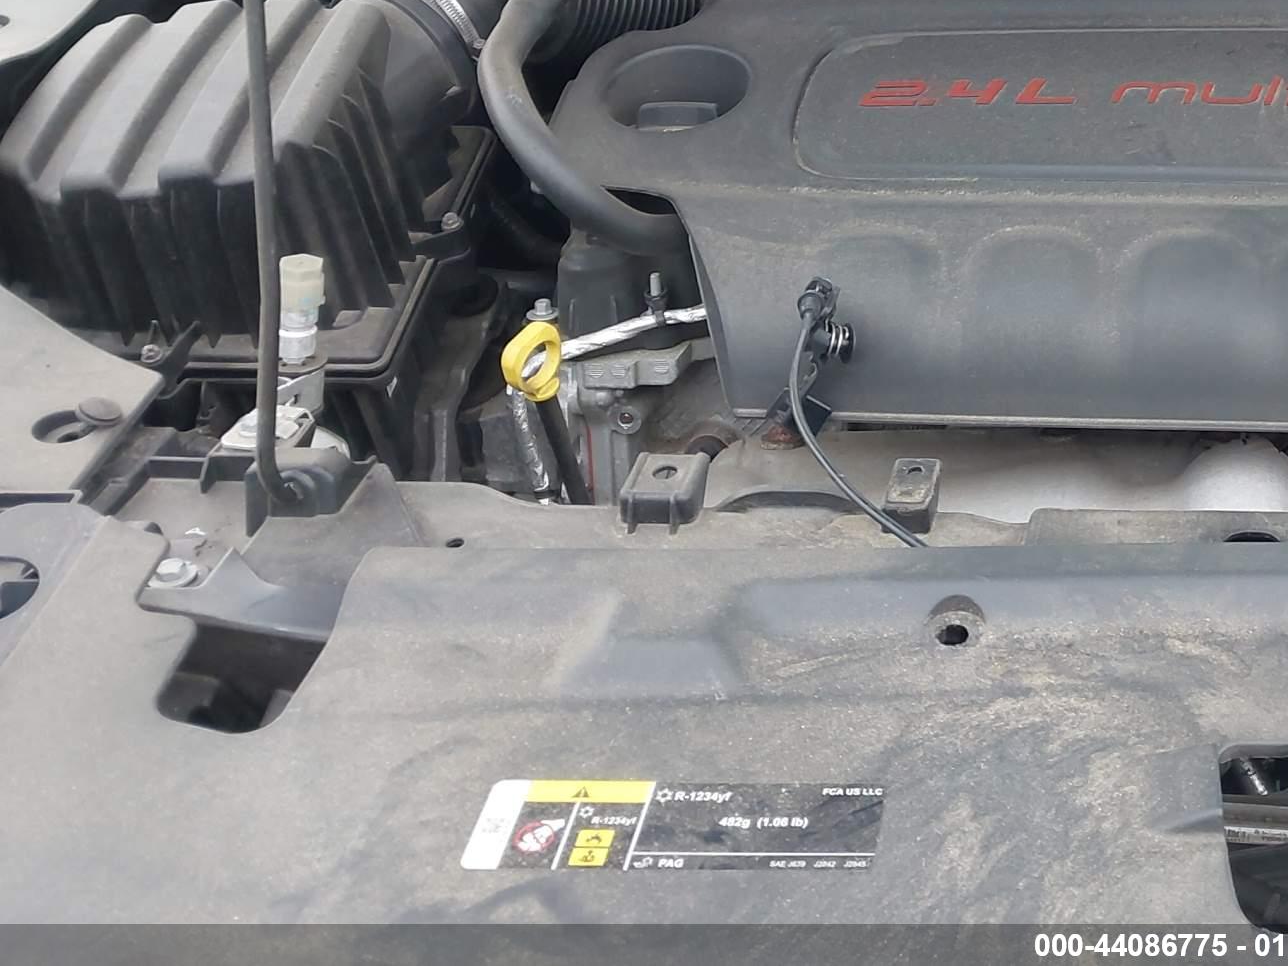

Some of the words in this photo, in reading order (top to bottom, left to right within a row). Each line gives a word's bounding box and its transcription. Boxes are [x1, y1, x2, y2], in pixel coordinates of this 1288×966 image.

[859, 77, 1078, 107] 2.4L
[674, 790, 733, 804] R-1234yf
[822, 787, 844, 796] FCA
[845, 787, 861, 796] US
[862, 787, 884, 796] LLC
[718, 816, 751, 830] 482g
[790, 816, 809, 830] lb)
[658, 858, 684, 869] PAG
